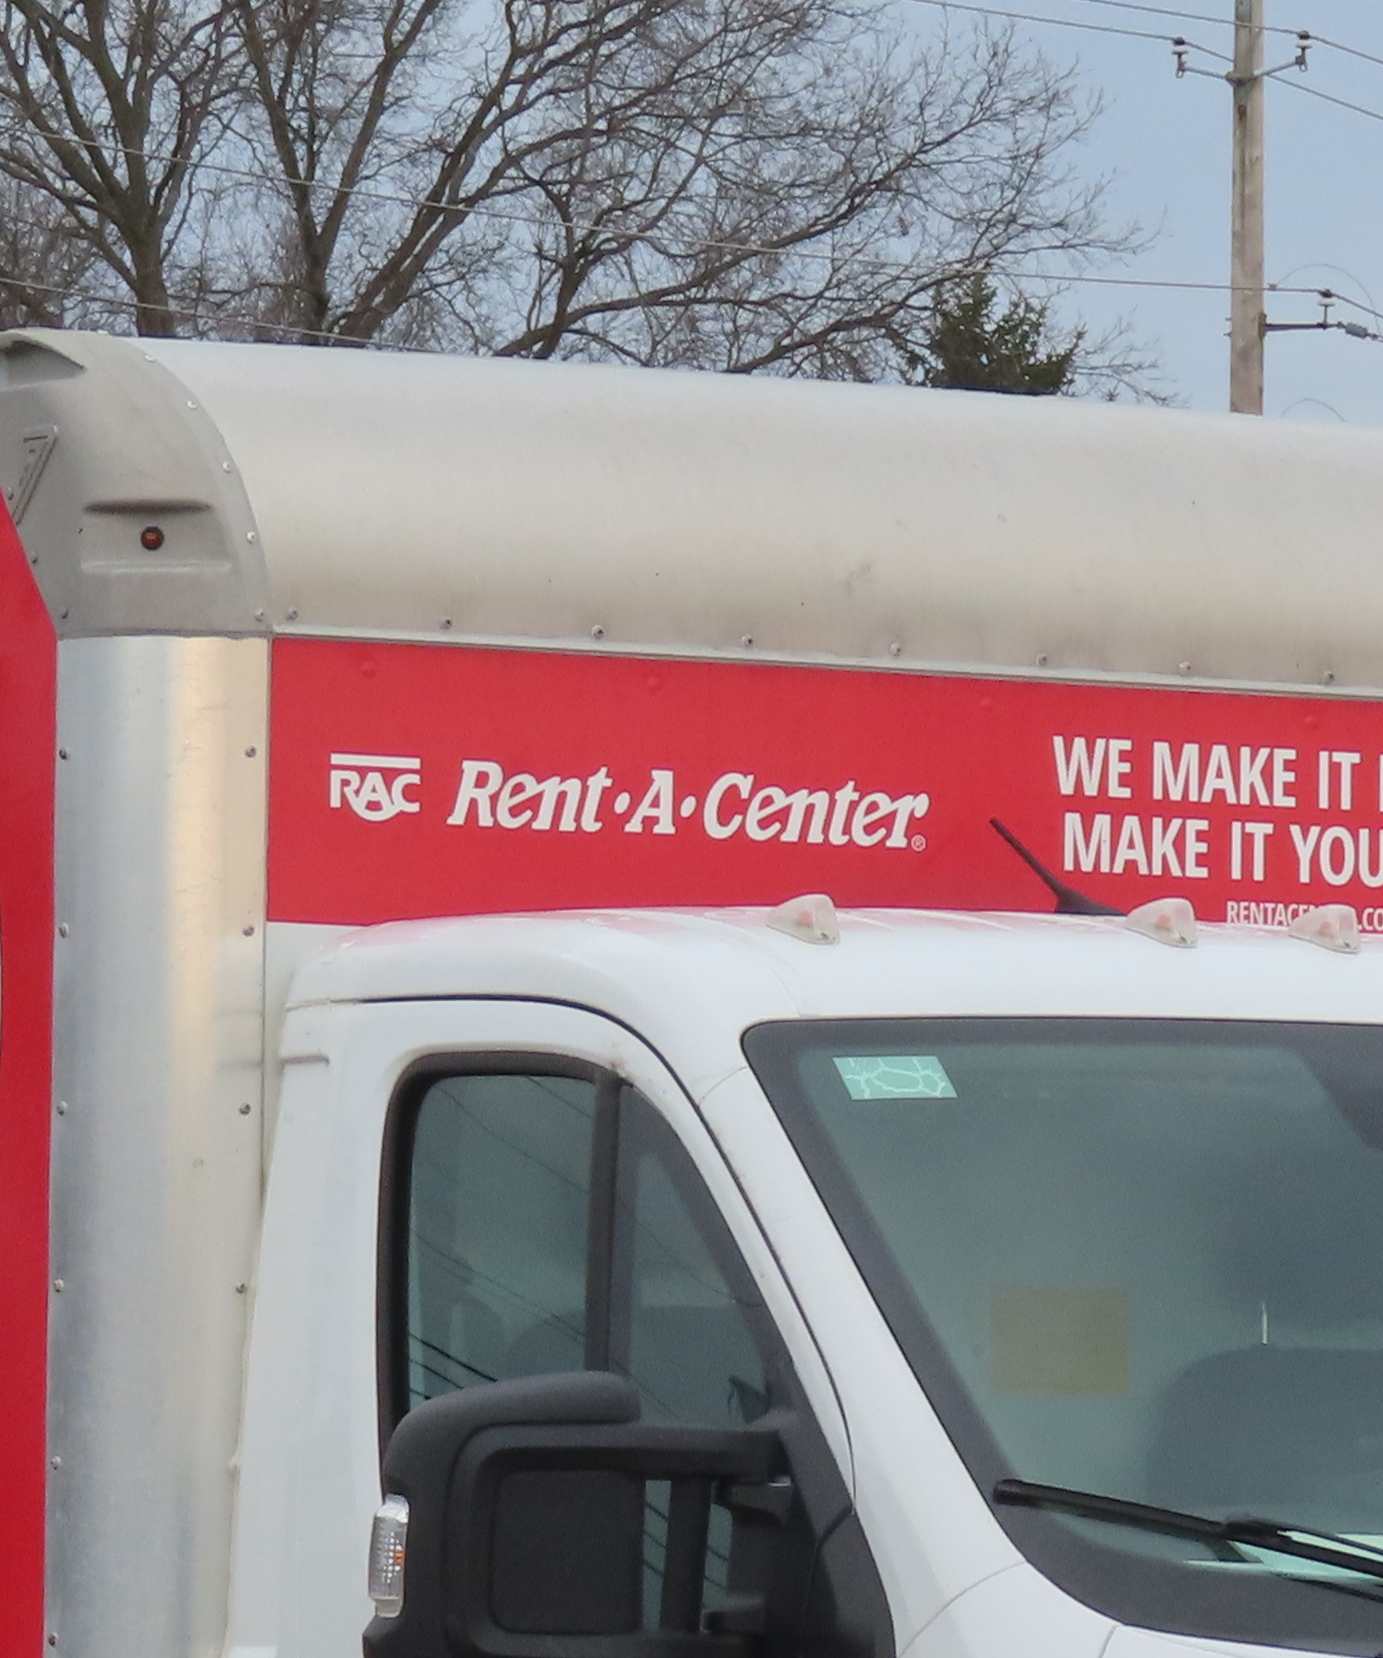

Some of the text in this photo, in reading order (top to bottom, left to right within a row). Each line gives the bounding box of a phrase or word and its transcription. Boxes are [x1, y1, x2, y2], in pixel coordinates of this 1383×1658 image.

[329, 769, 421, 822] RAC
[1052, 735, 1133, 799] WE
[1152, 740, 1298, 809] MAKE
[1318, 750, 1360, 812] IT
[1062, 811, 1210, 879] MAKE
[1229, 820, 1274, 882] IT
